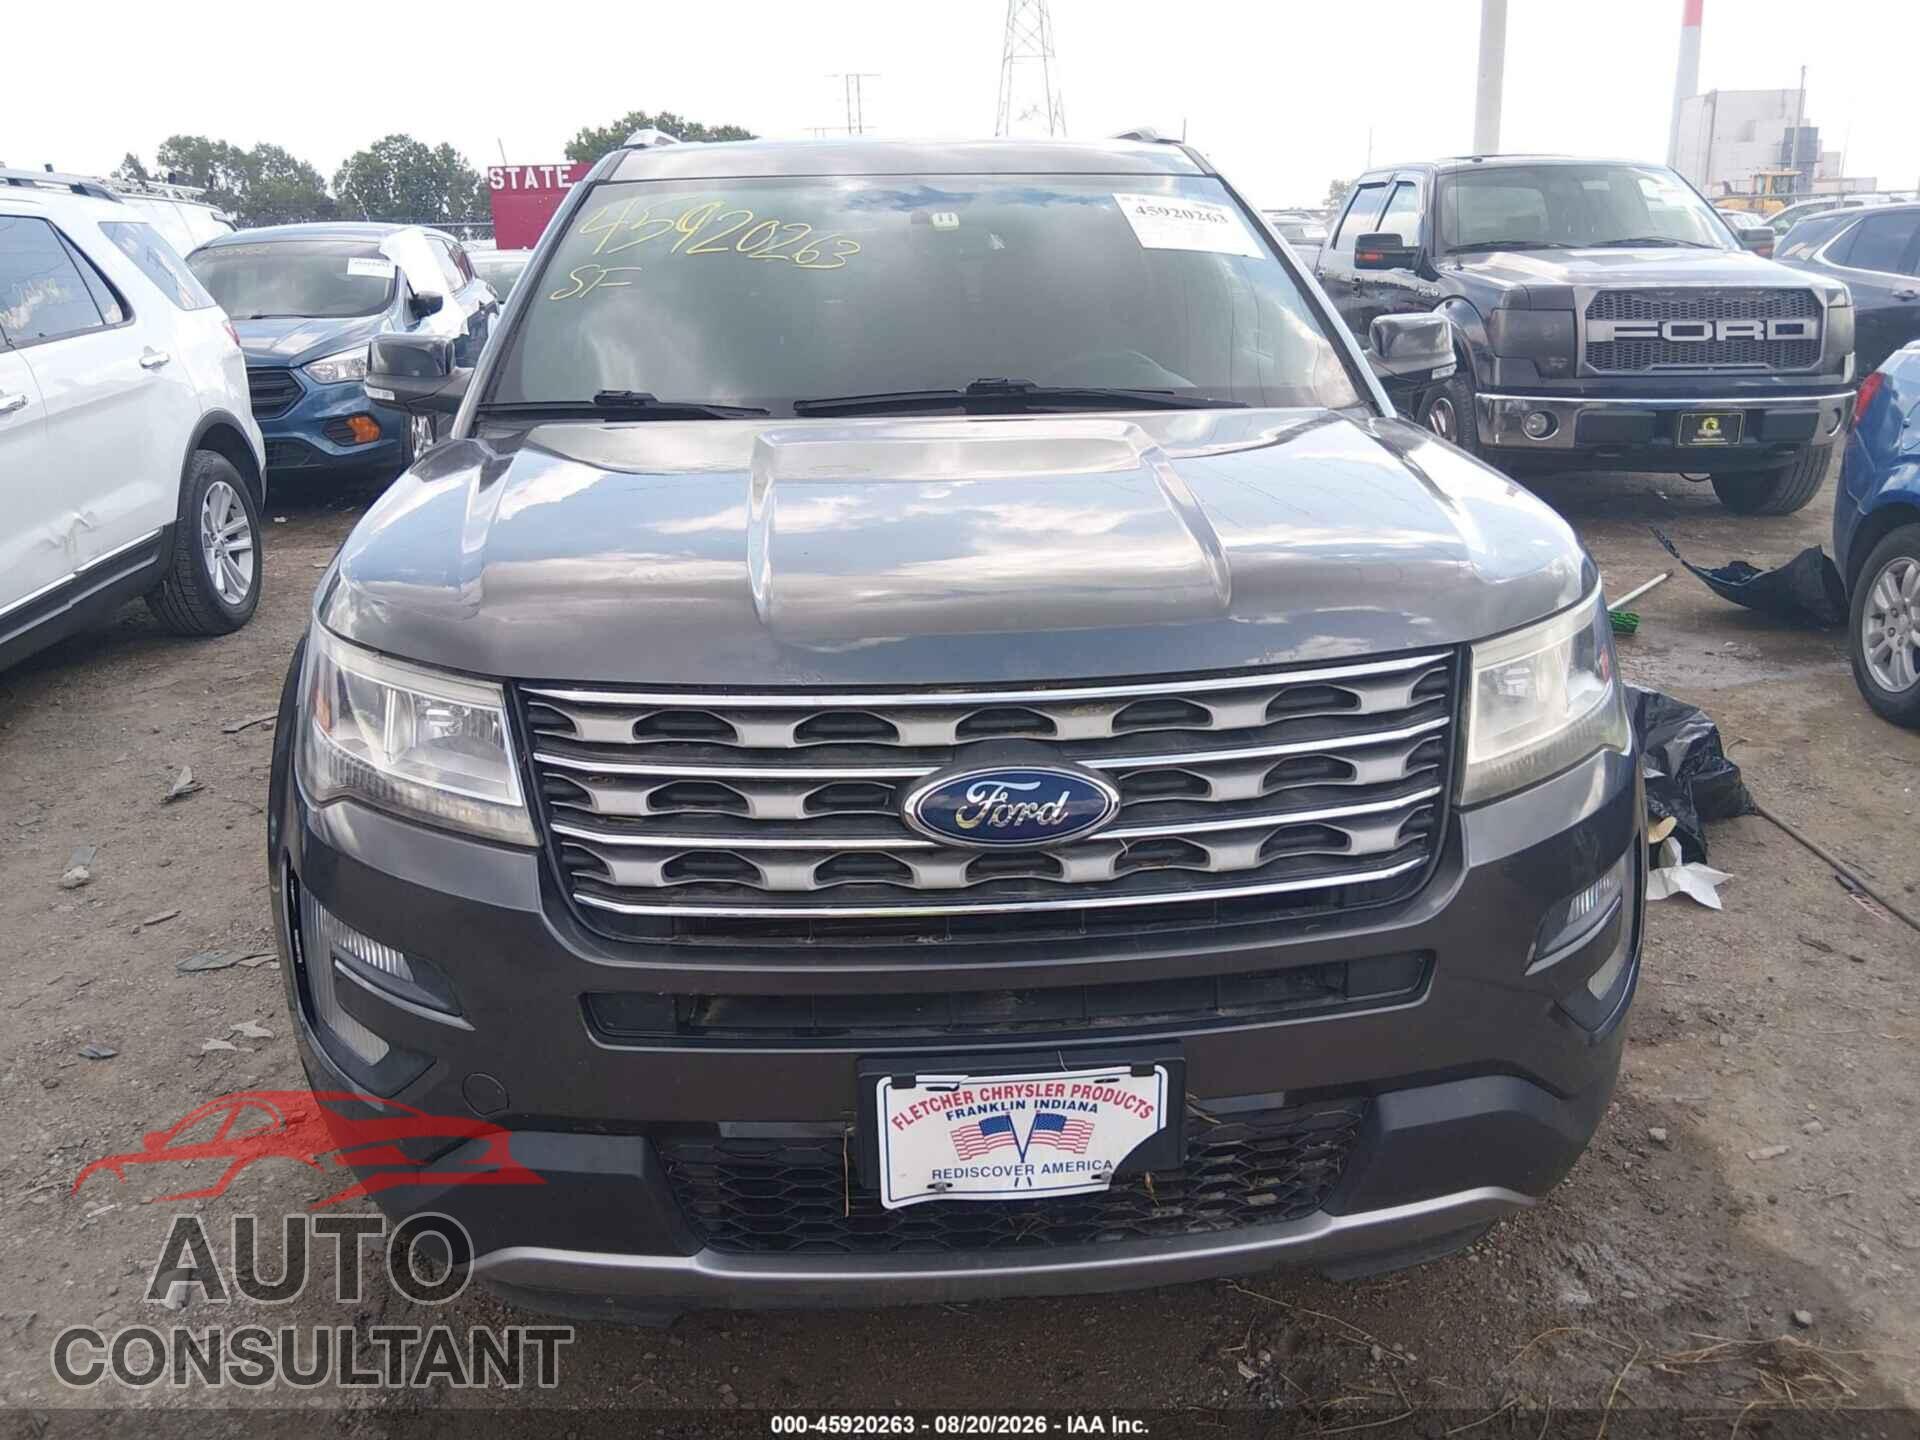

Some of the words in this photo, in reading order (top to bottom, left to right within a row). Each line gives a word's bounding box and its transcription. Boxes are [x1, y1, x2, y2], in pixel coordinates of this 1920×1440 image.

[489, 165, 573, 190] STATE
[580, 196, 861, 269] 45920263
[1593, 319, 1816, 342] FORD
[955, 780, 1071, 829] Ford
[892, 1086, 974, 1131] FLETCHER
[979, 1083, 1065, 1101] CHRYSLER
[1072, 1085, 1154, 1120] PRODUCTS
[945, 1100, 1026, 1121] FRANKLIN
[1034, 1099, 1098, 1114] INDIANA
[931, 1164, 1035, 1180] REDISCOVER
[1041, 1159, 1113, 1174] AMERICA
